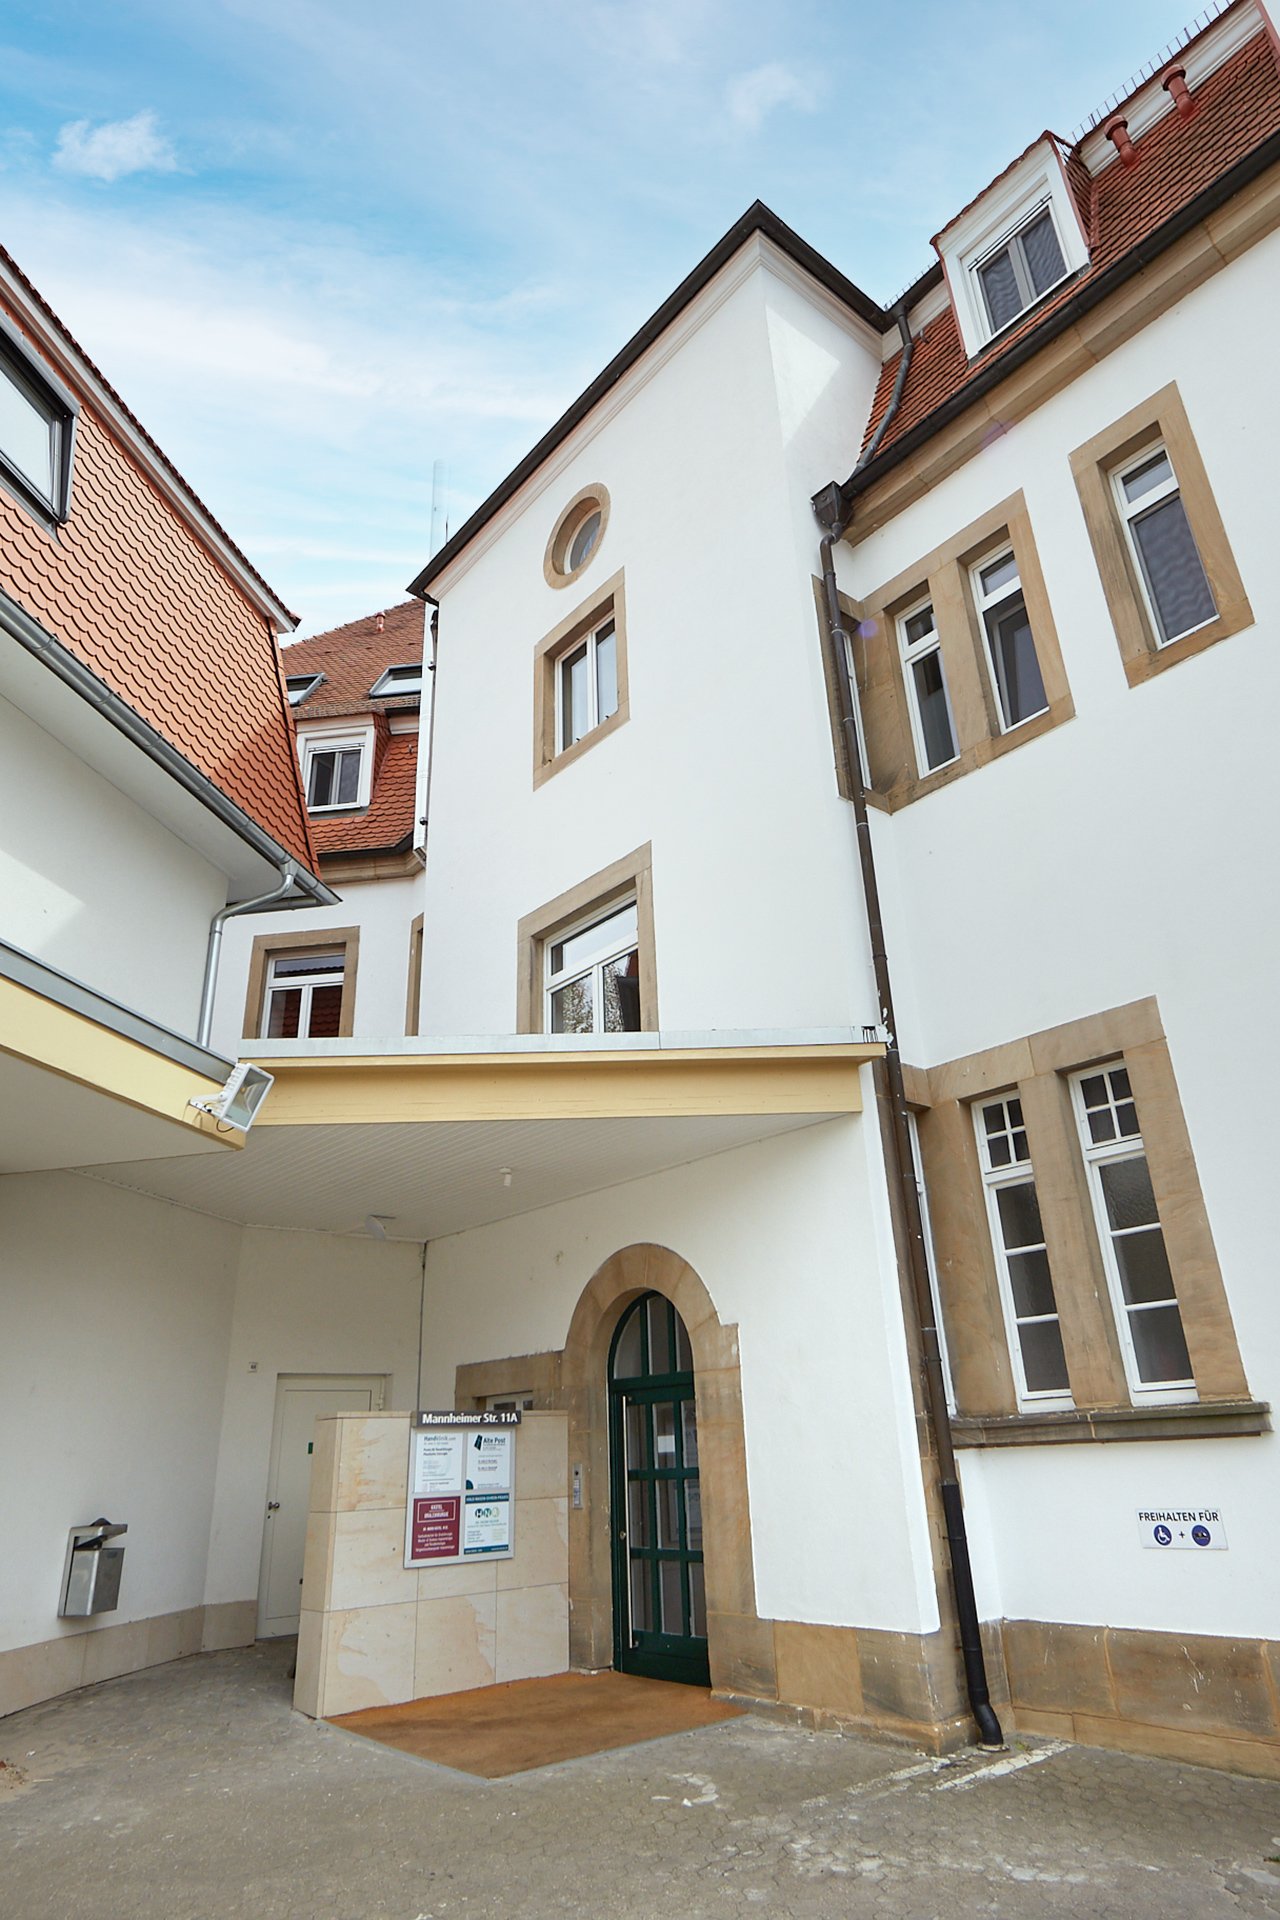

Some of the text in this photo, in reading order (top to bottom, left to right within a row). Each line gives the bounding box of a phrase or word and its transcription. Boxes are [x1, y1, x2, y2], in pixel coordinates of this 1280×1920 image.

[422, 1413, 518, 1424] Mannheimer Str. 11A
[1138, 1510, 1220, 1522] FREIHALTEN FÜR
